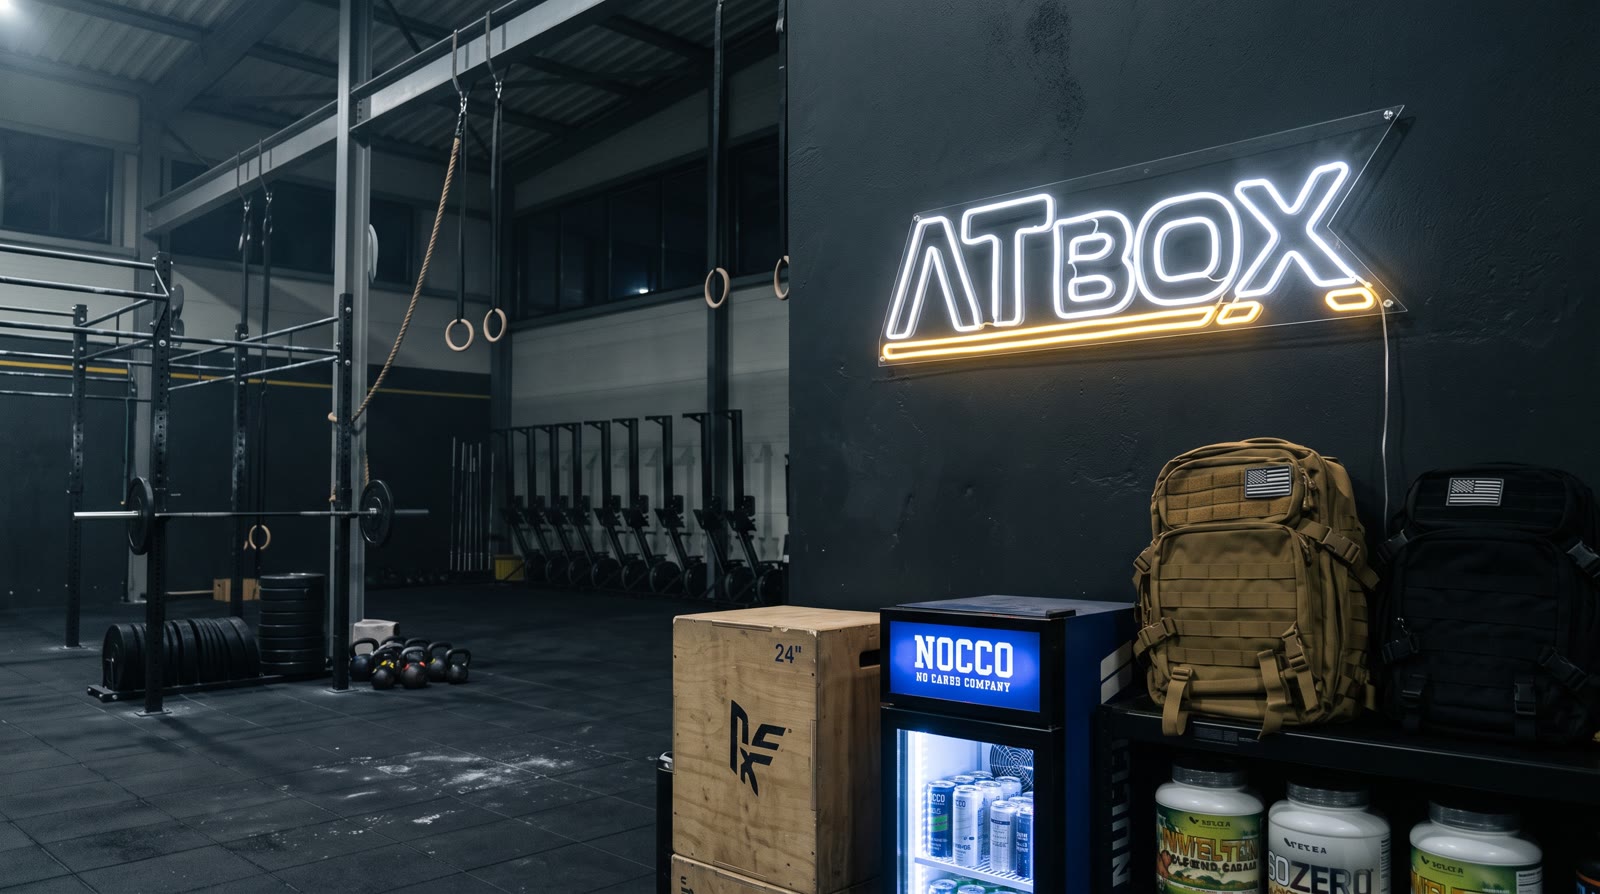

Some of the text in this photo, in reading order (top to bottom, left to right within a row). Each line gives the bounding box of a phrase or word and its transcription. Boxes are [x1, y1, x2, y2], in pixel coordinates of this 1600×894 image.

[886, 161, 1349, 339] ATBOX
[775, 643, 801, 664] 24"
[914, 634, 1013, 679] NOCCO
[916, 672, 928, 683] NO
[964, 677, 1011, 693] COMPANY
